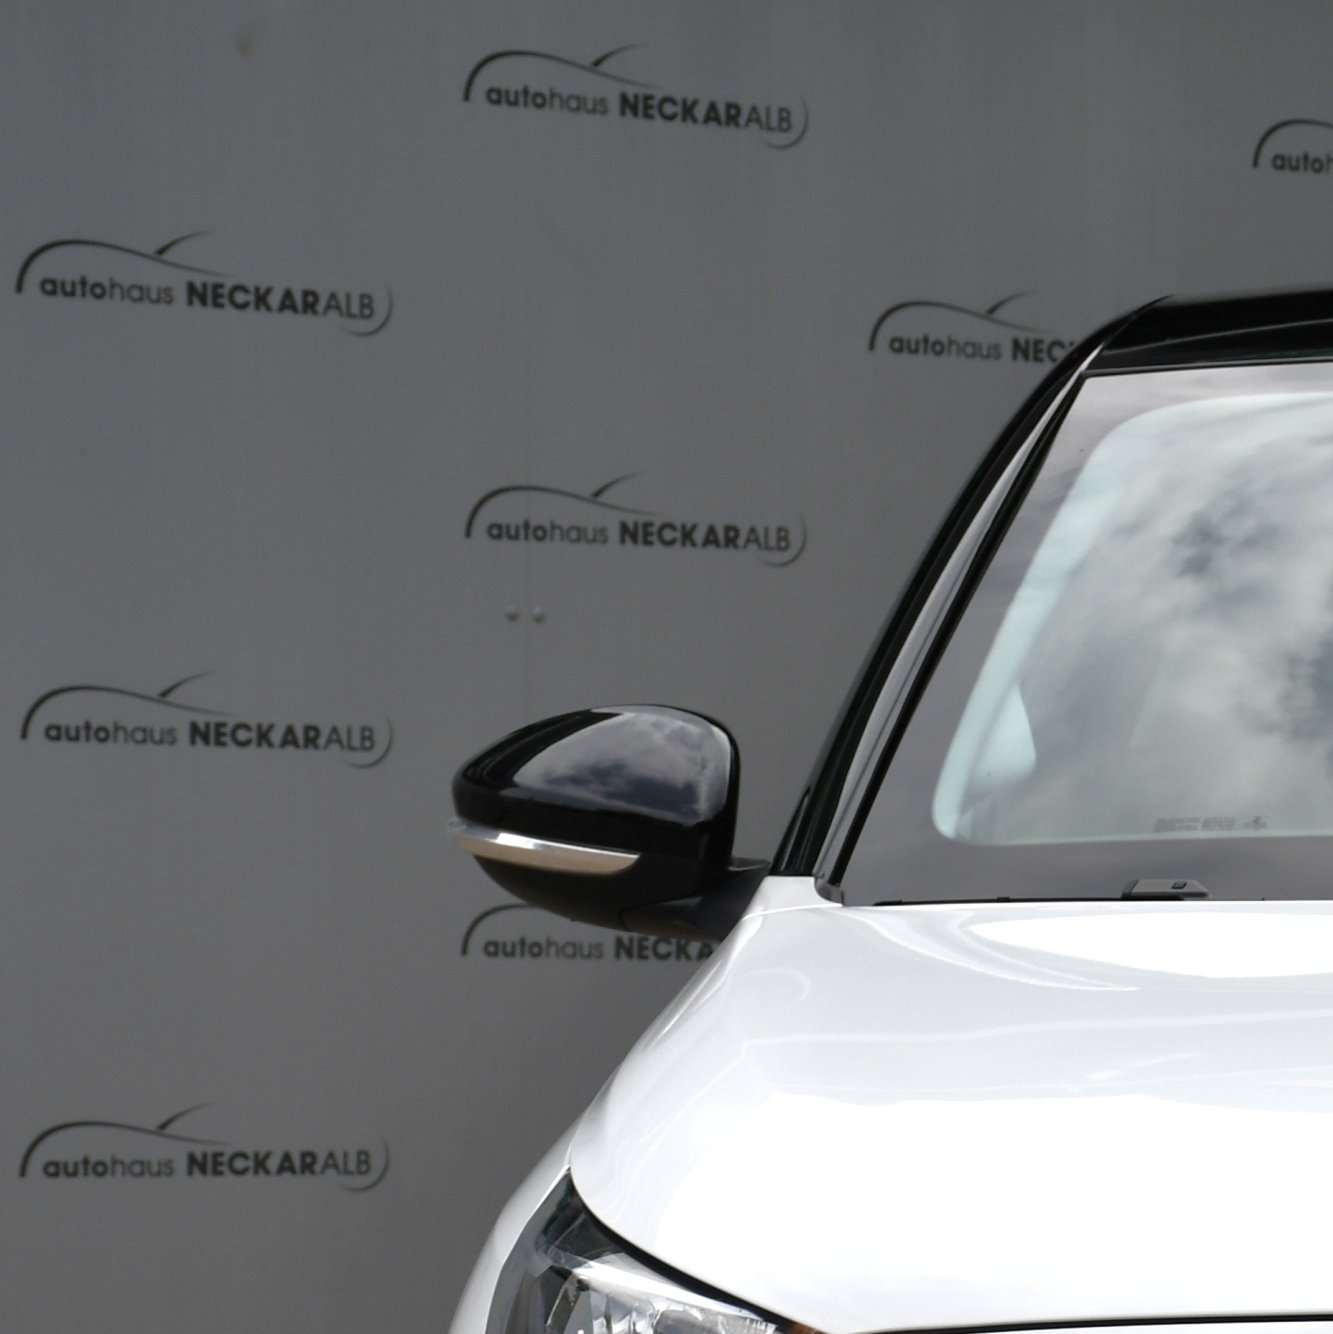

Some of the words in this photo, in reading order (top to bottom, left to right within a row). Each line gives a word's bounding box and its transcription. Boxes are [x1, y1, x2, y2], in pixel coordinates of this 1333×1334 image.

[485, 83, 608, 116] autohaus
[619, 91, 793, 134] NECKARALB
[40, 274, 174, 305] autohaus
[186, 280, 374, 320] NECKARALB
[889, 333, 1001, 360] autohaus
[1012, 337, 1073, 363] NEC
[487, 519, 608, 546] autohaus
[619, 520, 790, 552] NECKARALB
[44, 720, 177, 747] autohaus
[189, 721, 375, 752] NECKARALB
[484, 936, 604, 961] autohaus
[615, 936, 720, 960] NECKA
[44, 1152, 174, 1180] autohaus
[187, 1150, 370, 1177] NECKARALB
